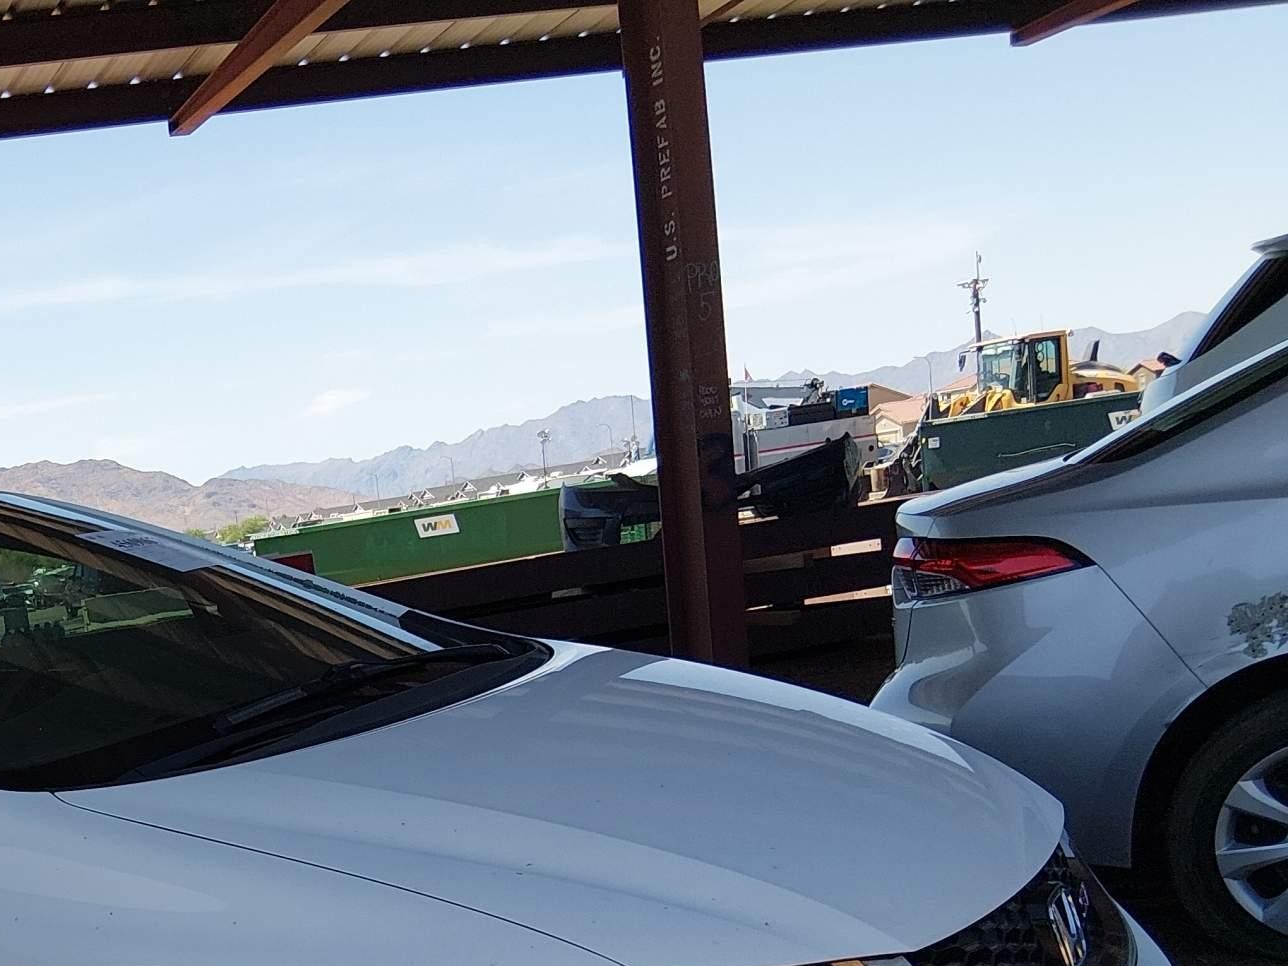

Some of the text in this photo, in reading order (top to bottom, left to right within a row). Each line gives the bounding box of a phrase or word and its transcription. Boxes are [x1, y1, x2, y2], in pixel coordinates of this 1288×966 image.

[648, 36, 678, 262] U.S. PREFAB INC.
[421, 518, 452, 532] WM
